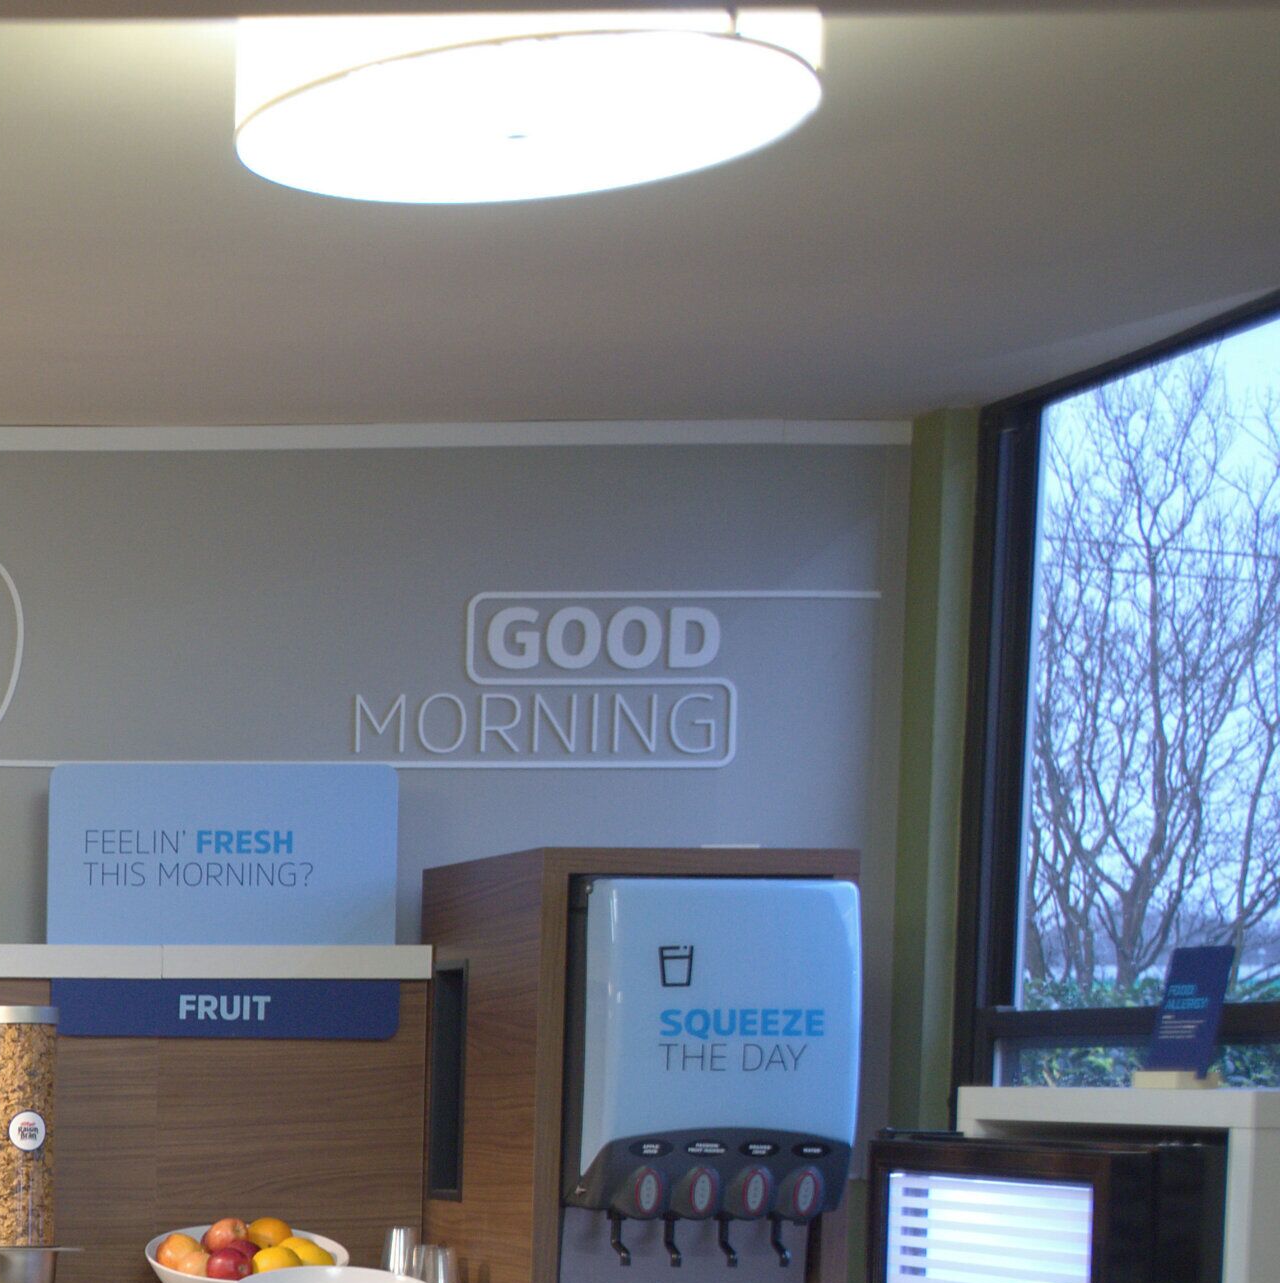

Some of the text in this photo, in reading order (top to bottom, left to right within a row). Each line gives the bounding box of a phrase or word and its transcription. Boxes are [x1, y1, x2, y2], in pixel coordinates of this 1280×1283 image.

[487, 605, 721, 669] GOOD
[354, 692, 717, 754] MORNING
[196, 829, 294, 855] FRESH
[83, 861, 314, 888] THIS MORNING?
[178, 994, 271, 1021] FRUIT
[659, 1008, 825, 1040] SQUEEZE
[658, 1043, 808, 1072] THE DAY
